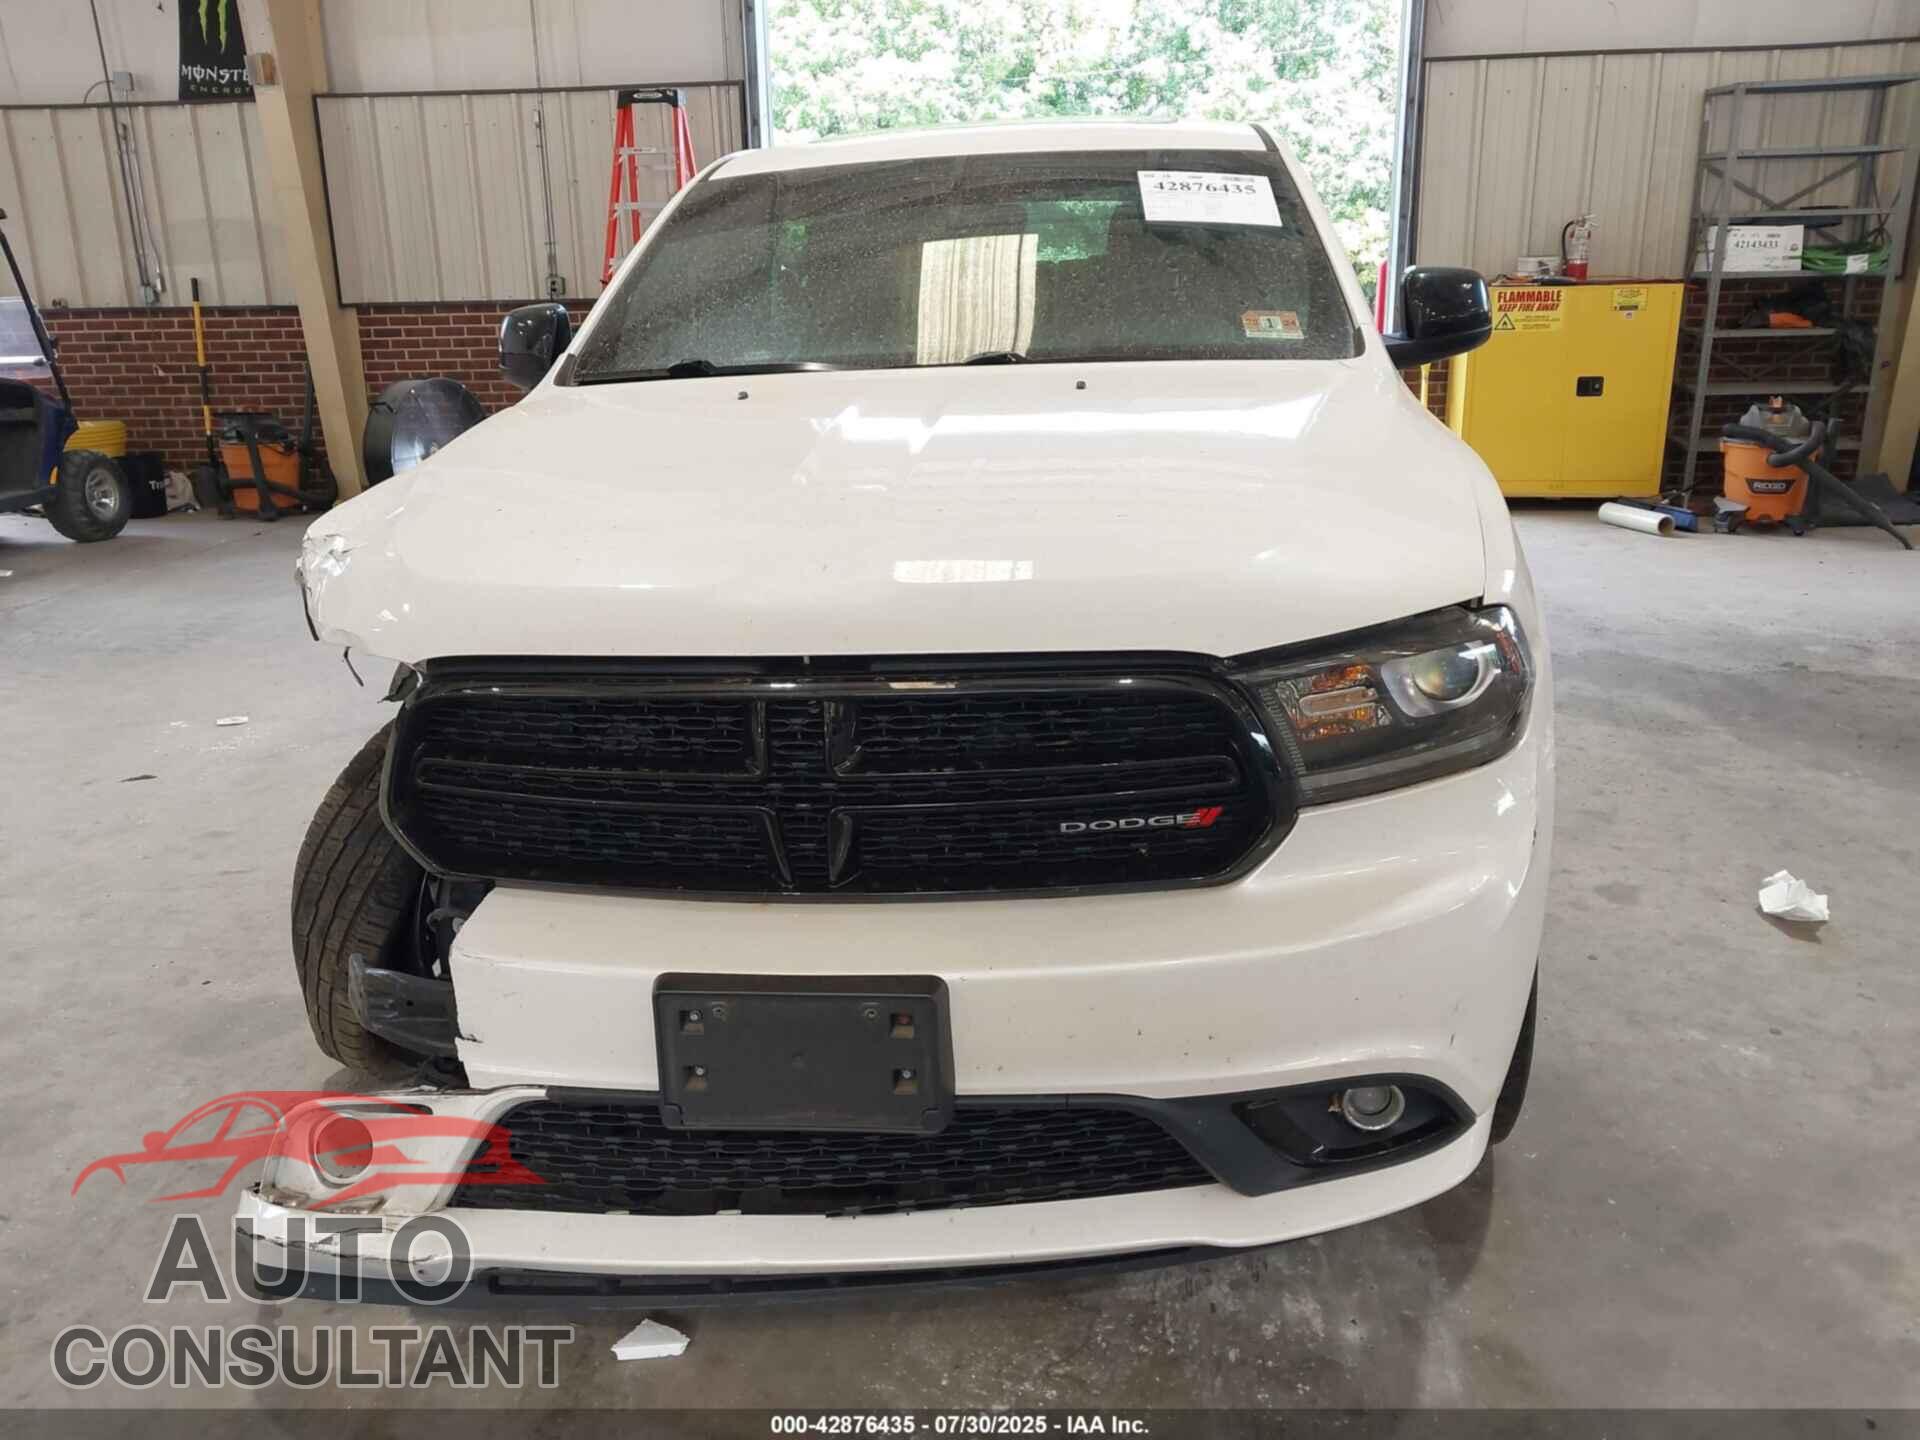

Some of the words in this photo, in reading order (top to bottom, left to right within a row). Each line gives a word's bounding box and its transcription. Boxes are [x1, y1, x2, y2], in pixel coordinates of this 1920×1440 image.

[181, 64, 249, 84] MONSTE
[1153, 181, 1257, 195] 42876435
[1497, 290, 1562, 303] FLAMMABLE
[1060, 813, 1201, 833] DODGE
